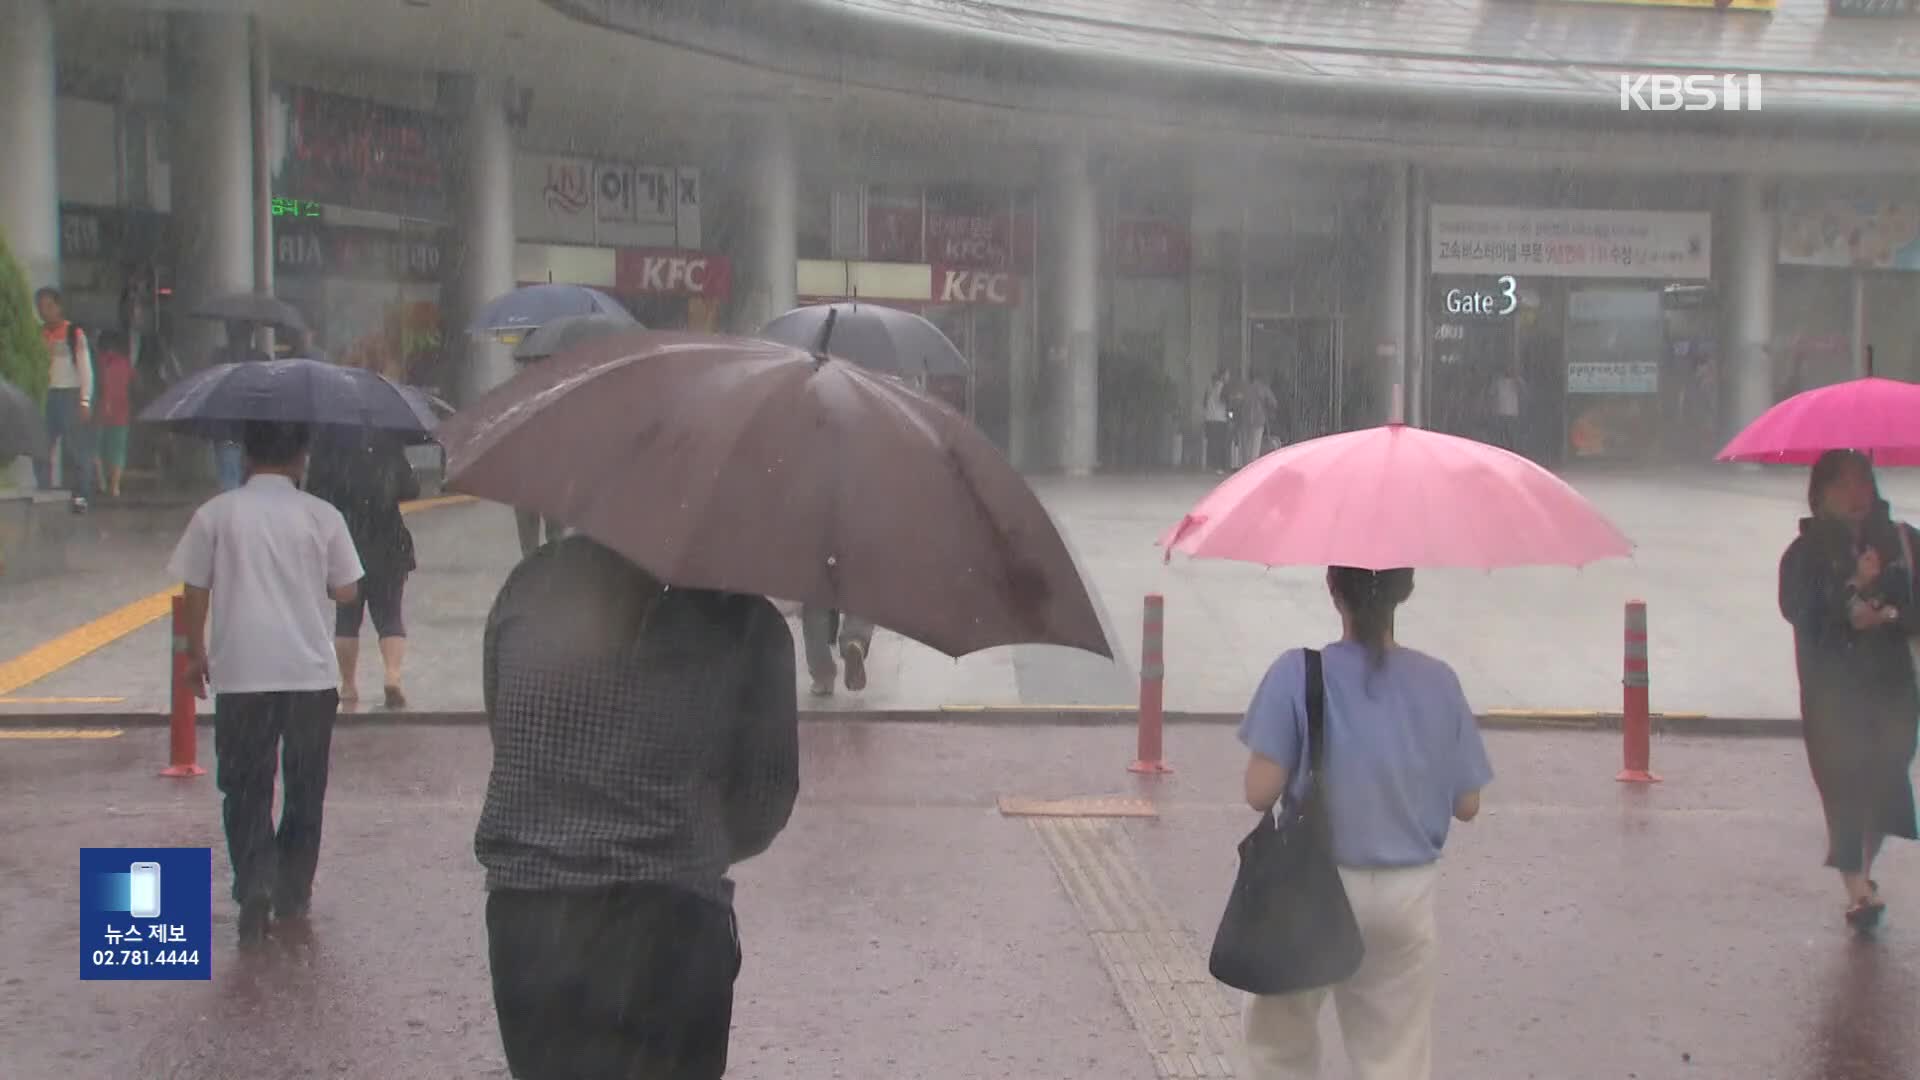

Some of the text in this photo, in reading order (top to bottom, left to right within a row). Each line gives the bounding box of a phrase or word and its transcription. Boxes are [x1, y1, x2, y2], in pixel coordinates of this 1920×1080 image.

[640, 256, 708, 292] KFC
[942, 271, 1008, 302] KFC
[1446, 275, 1517, 315] Gate 3
